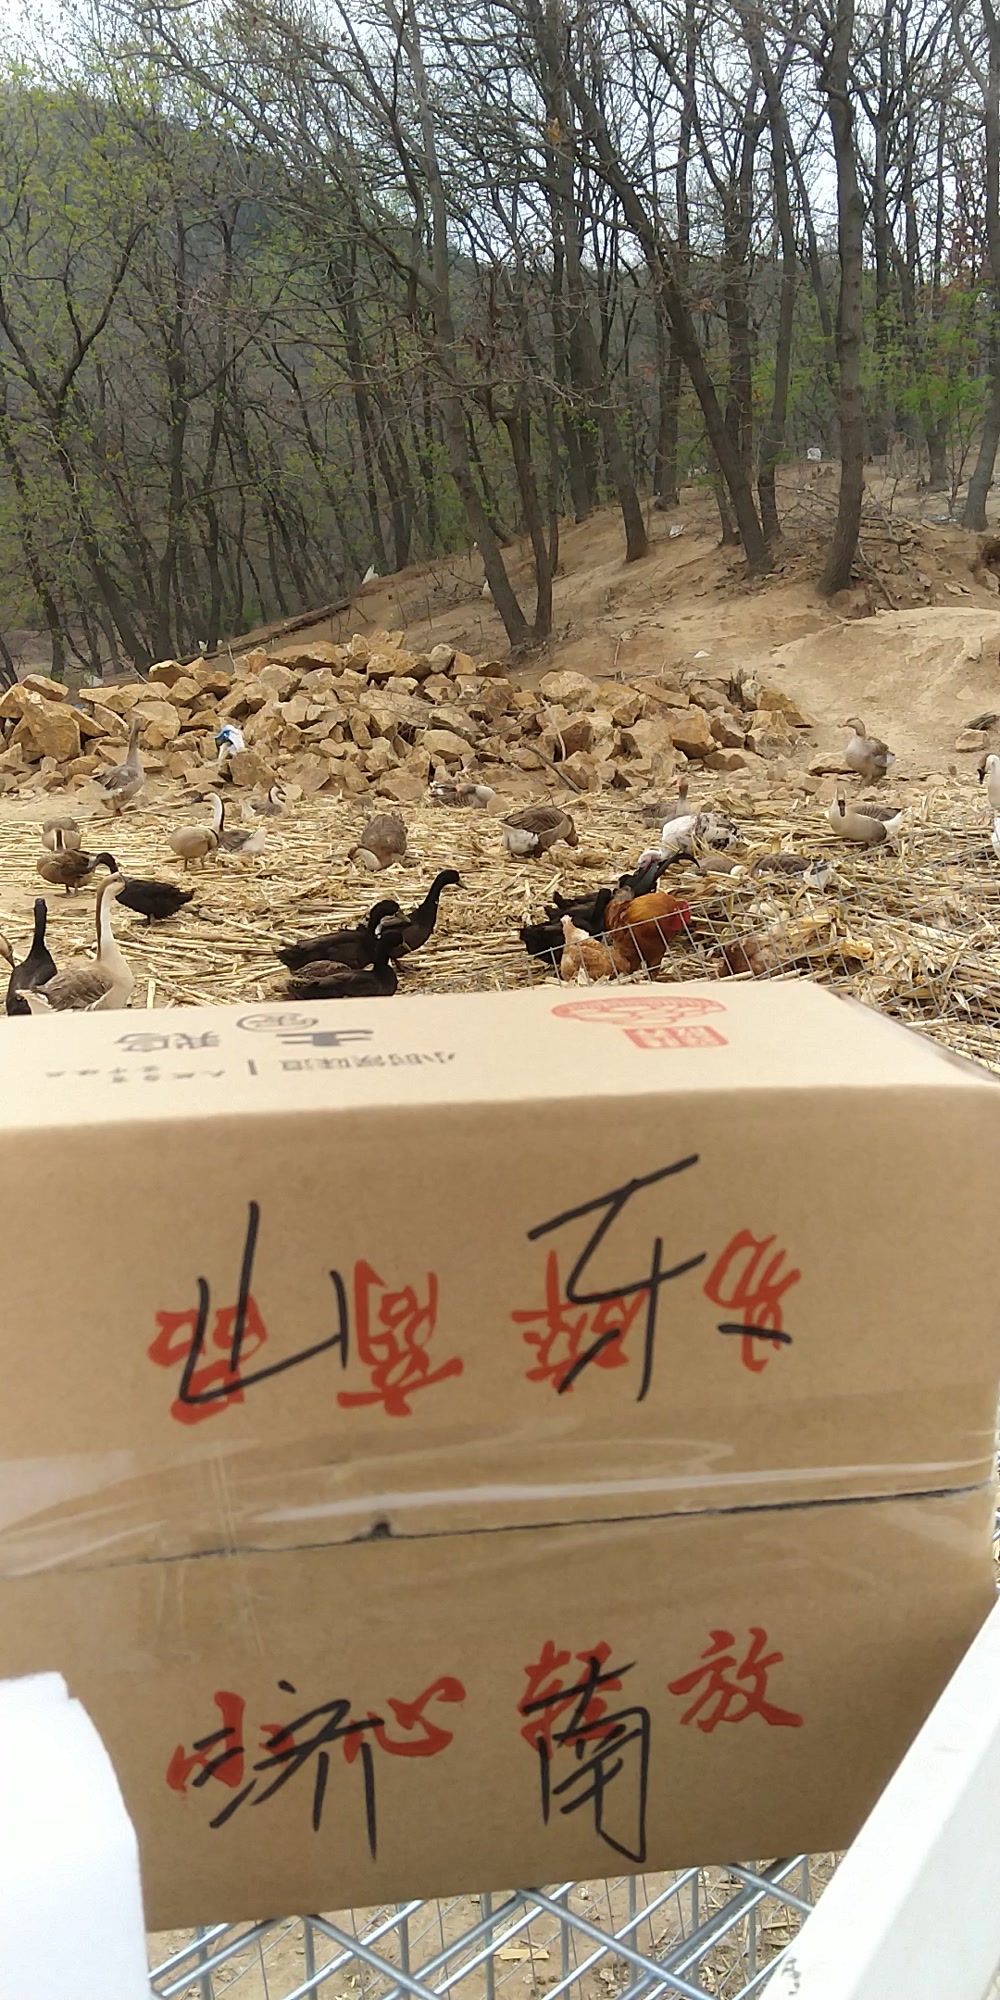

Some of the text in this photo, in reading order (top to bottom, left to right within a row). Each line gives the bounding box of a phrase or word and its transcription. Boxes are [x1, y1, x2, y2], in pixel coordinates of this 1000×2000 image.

[147, 1229, 801, 1425] 易碎商品
[166, 1628, 802, 1793] 小心轻放
[192, 1656, 650, 1863] 济南
